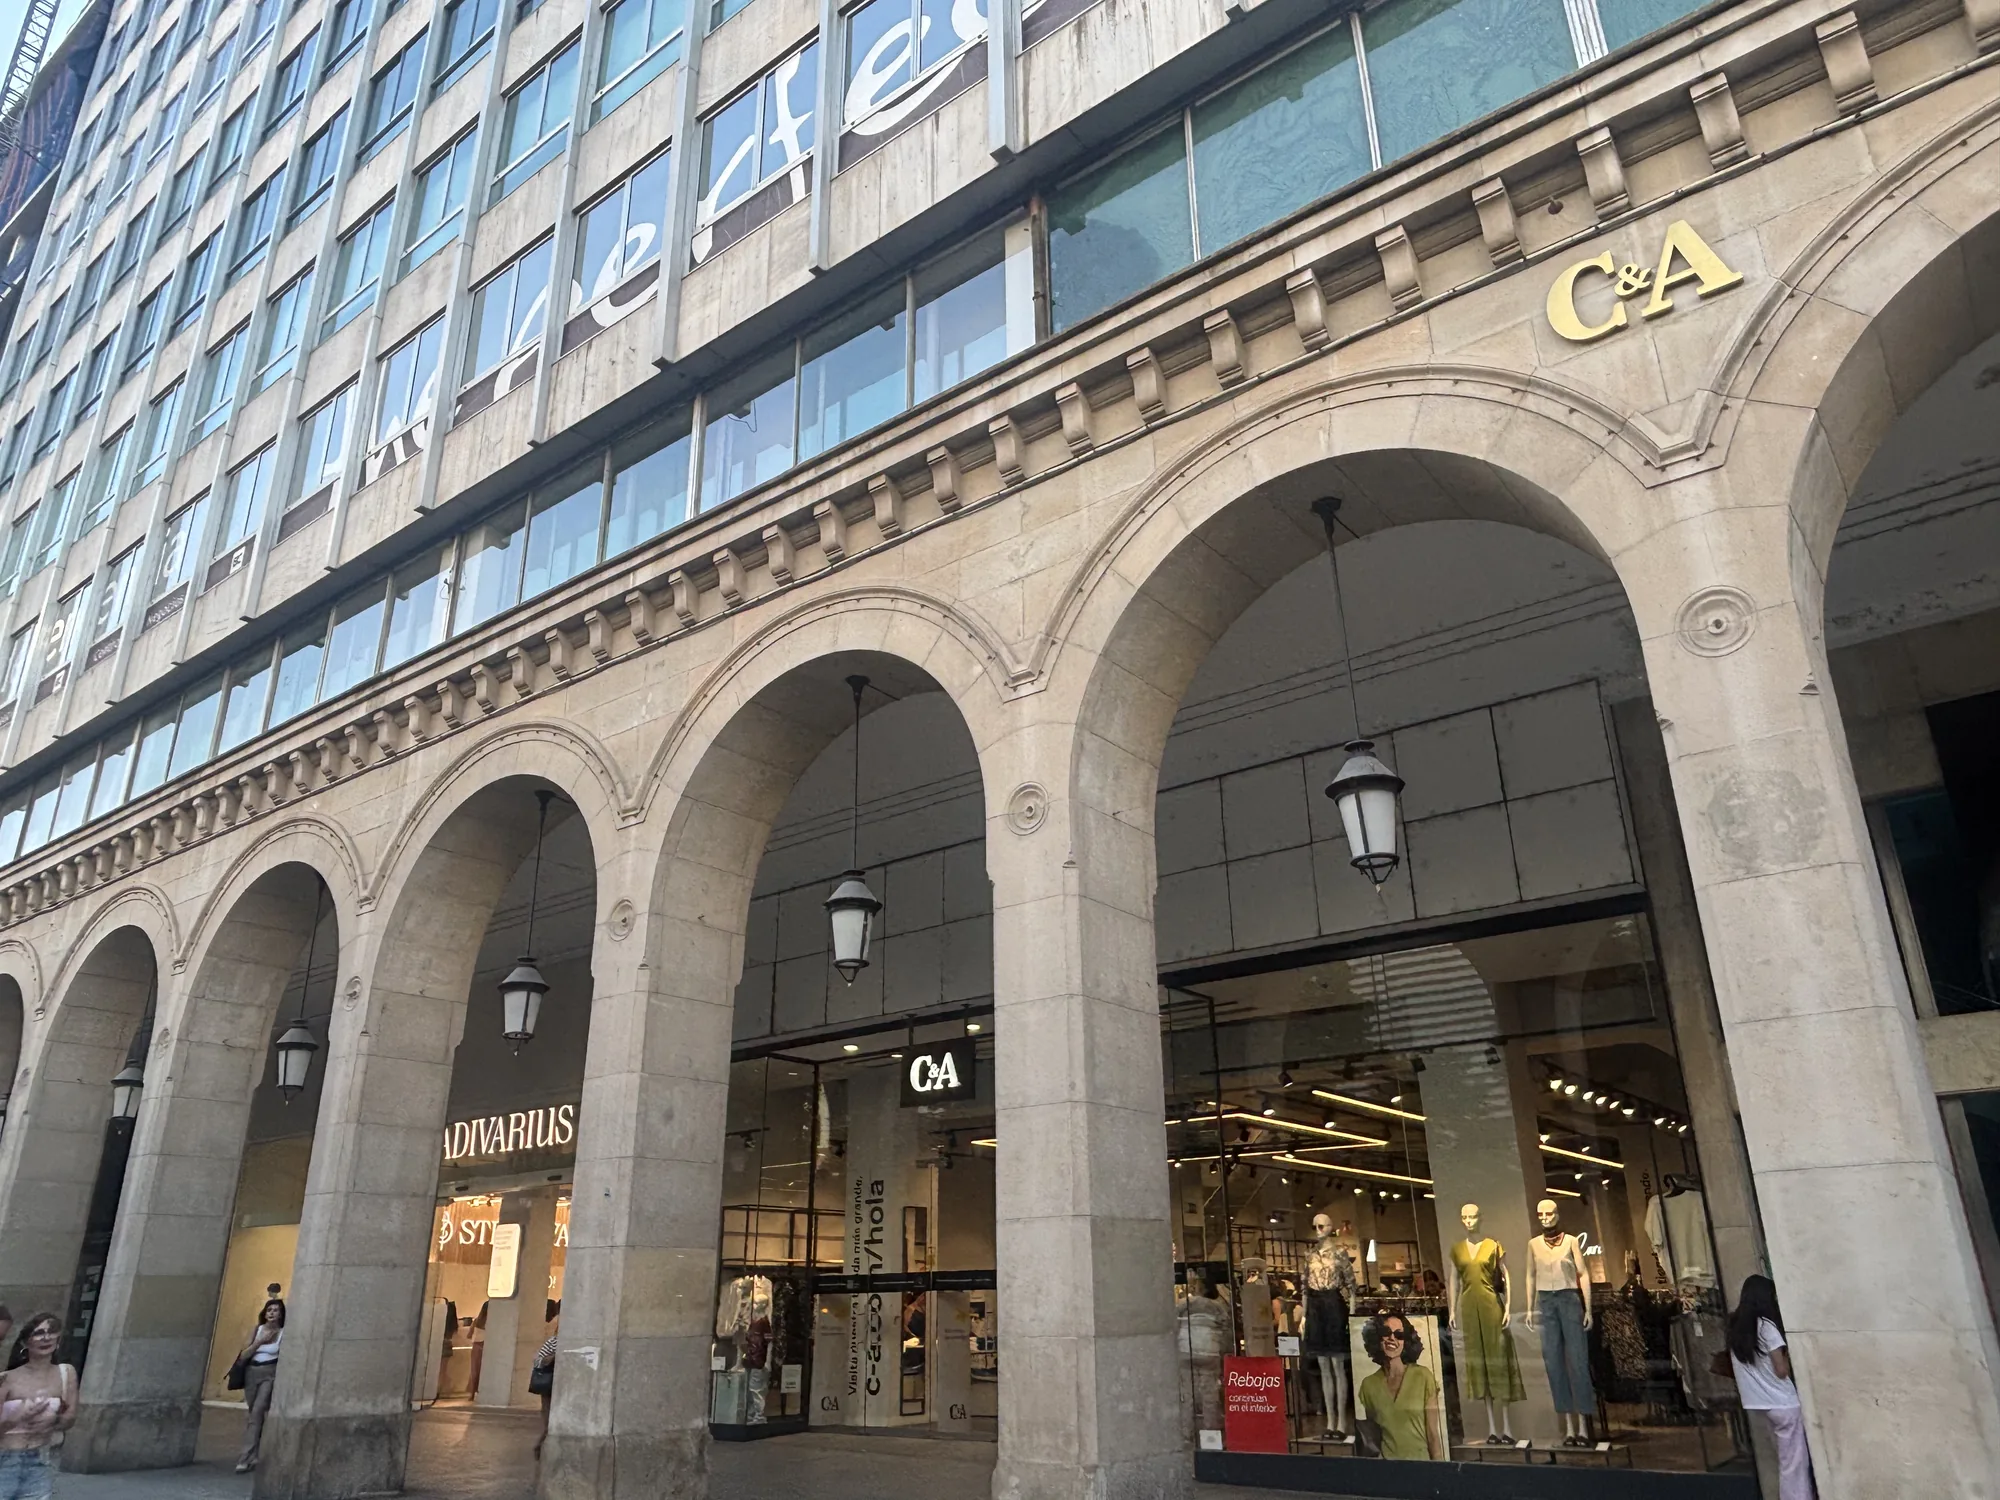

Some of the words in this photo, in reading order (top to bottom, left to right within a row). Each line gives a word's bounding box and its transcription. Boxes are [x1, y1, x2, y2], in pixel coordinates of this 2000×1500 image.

[1546, 219, 1744, 342] C&A
[910, 1052, 962, 1092] C&A
[1228, 1371, 1281, 1391] Rebajas
[1241, 1403, 1249, 1412] el
[1249, 1403, 1277, 1413] interior
